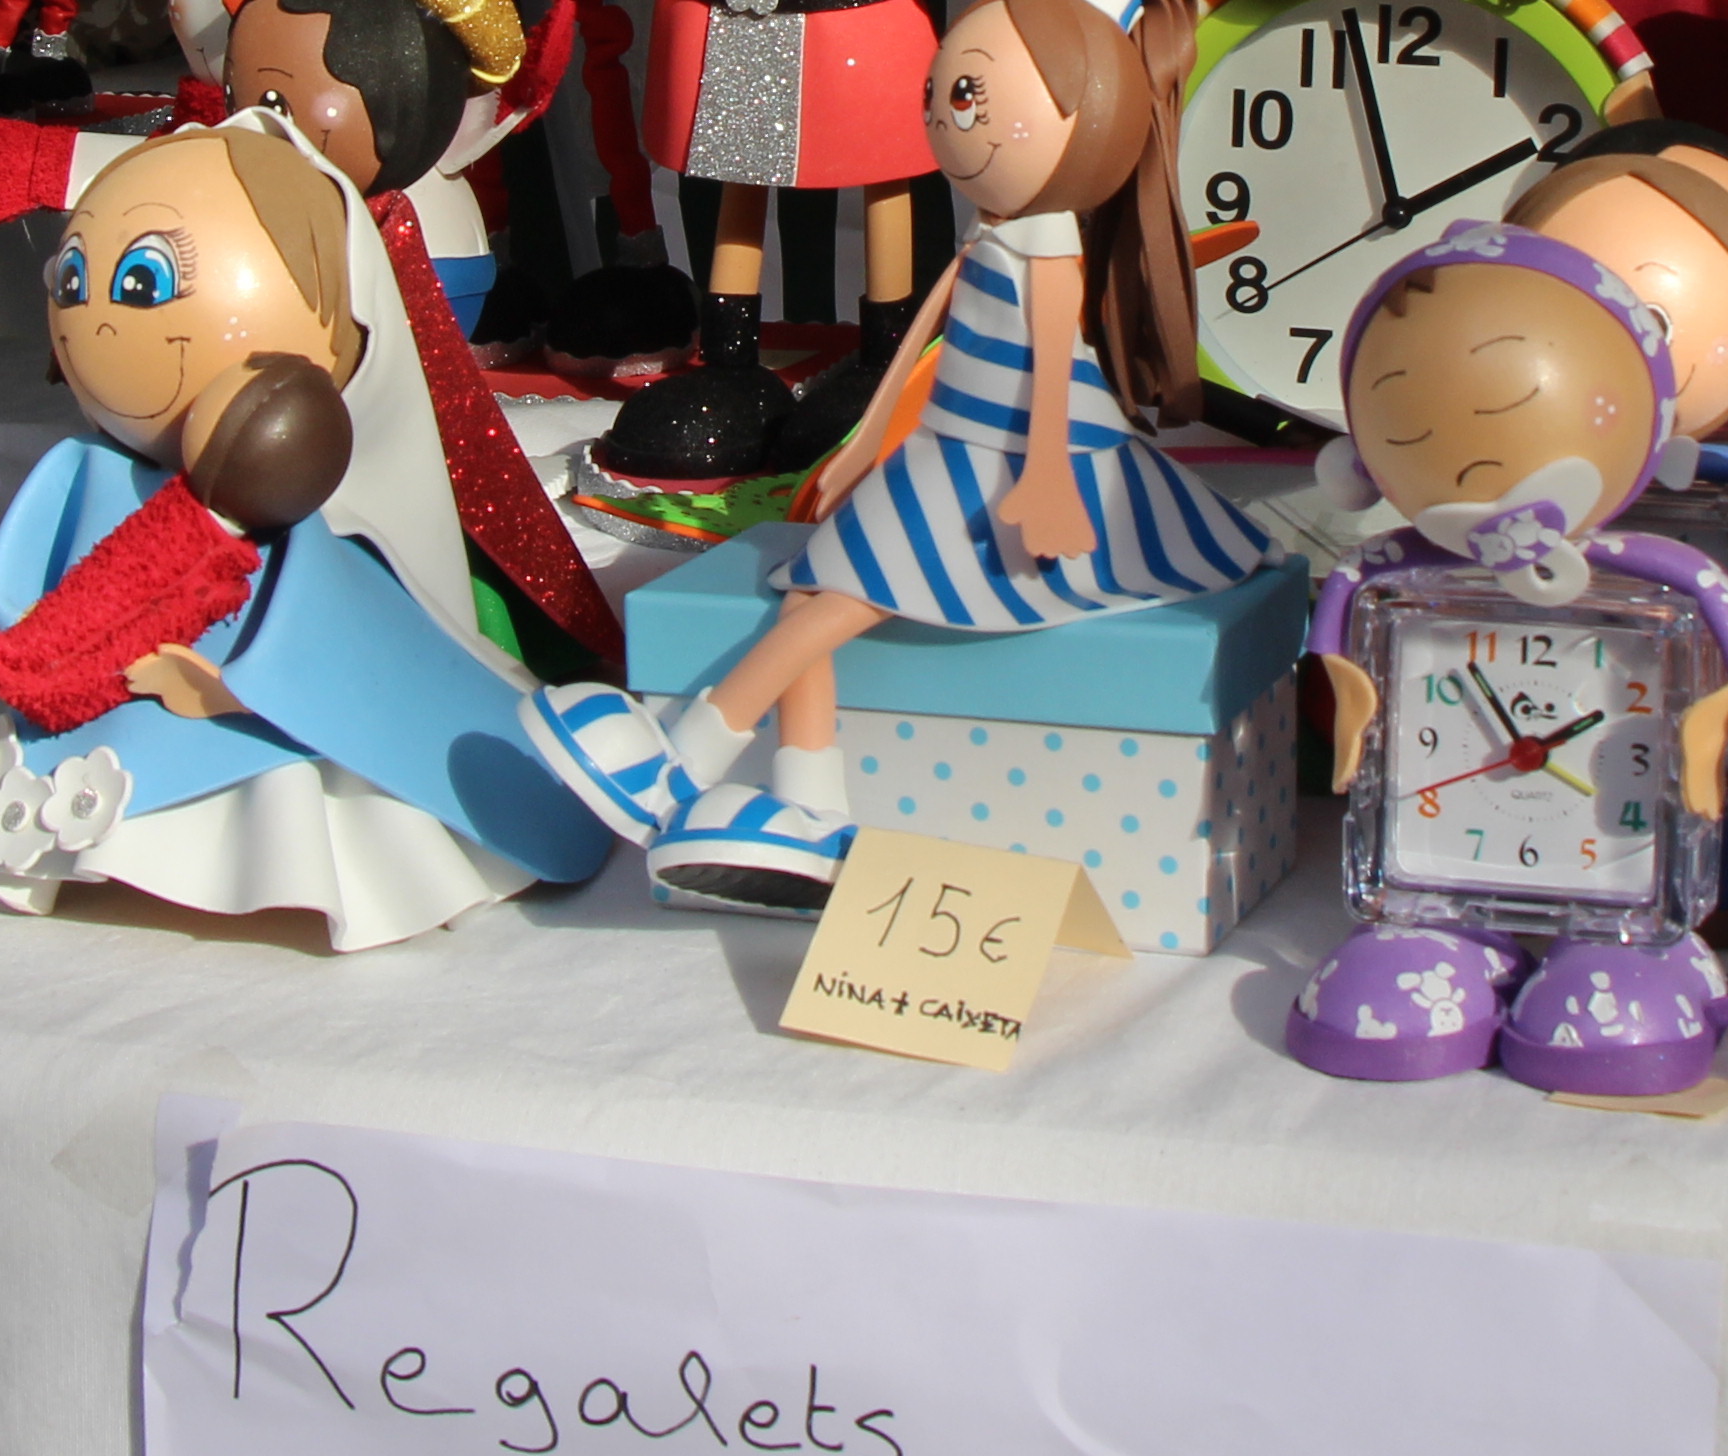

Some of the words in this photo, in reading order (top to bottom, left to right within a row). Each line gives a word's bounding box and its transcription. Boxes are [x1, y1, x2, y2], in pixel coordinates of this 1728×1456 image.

[1377, 4, 1442, 66] 12
[1299, 28, 1347, 89] 11
[1494, 37, 1509, 98] 1
[1230, 88, 1294, 150] 10
[1537, 104, 1583, 163] 2
[1205, 171, 1251, 225] 9
[1225, 255, 1269, 313] 8
[1289, 327, 1333, 383] 7
[1464, 630, 1497, 663] 11
[1518, 634, 1558, 668] 12
[1593, 638, 1605, 669] 1
[1424, 673, 1463, 706] 10
[1626, 681, 1654, 714] 2
[1418, 727, 1438, 758] 9
[1630, 743, 1650, 776] 3
[1416, 789, 1441, 819] 8
[1619, 801, 1647, 832] 4
[1465, 828, 1485, 861] 7
[1519, 835, 1539, 867] 6
[1580, 838, 1597, 869] 5
[208, 1158, 904, 1456] Regalets
